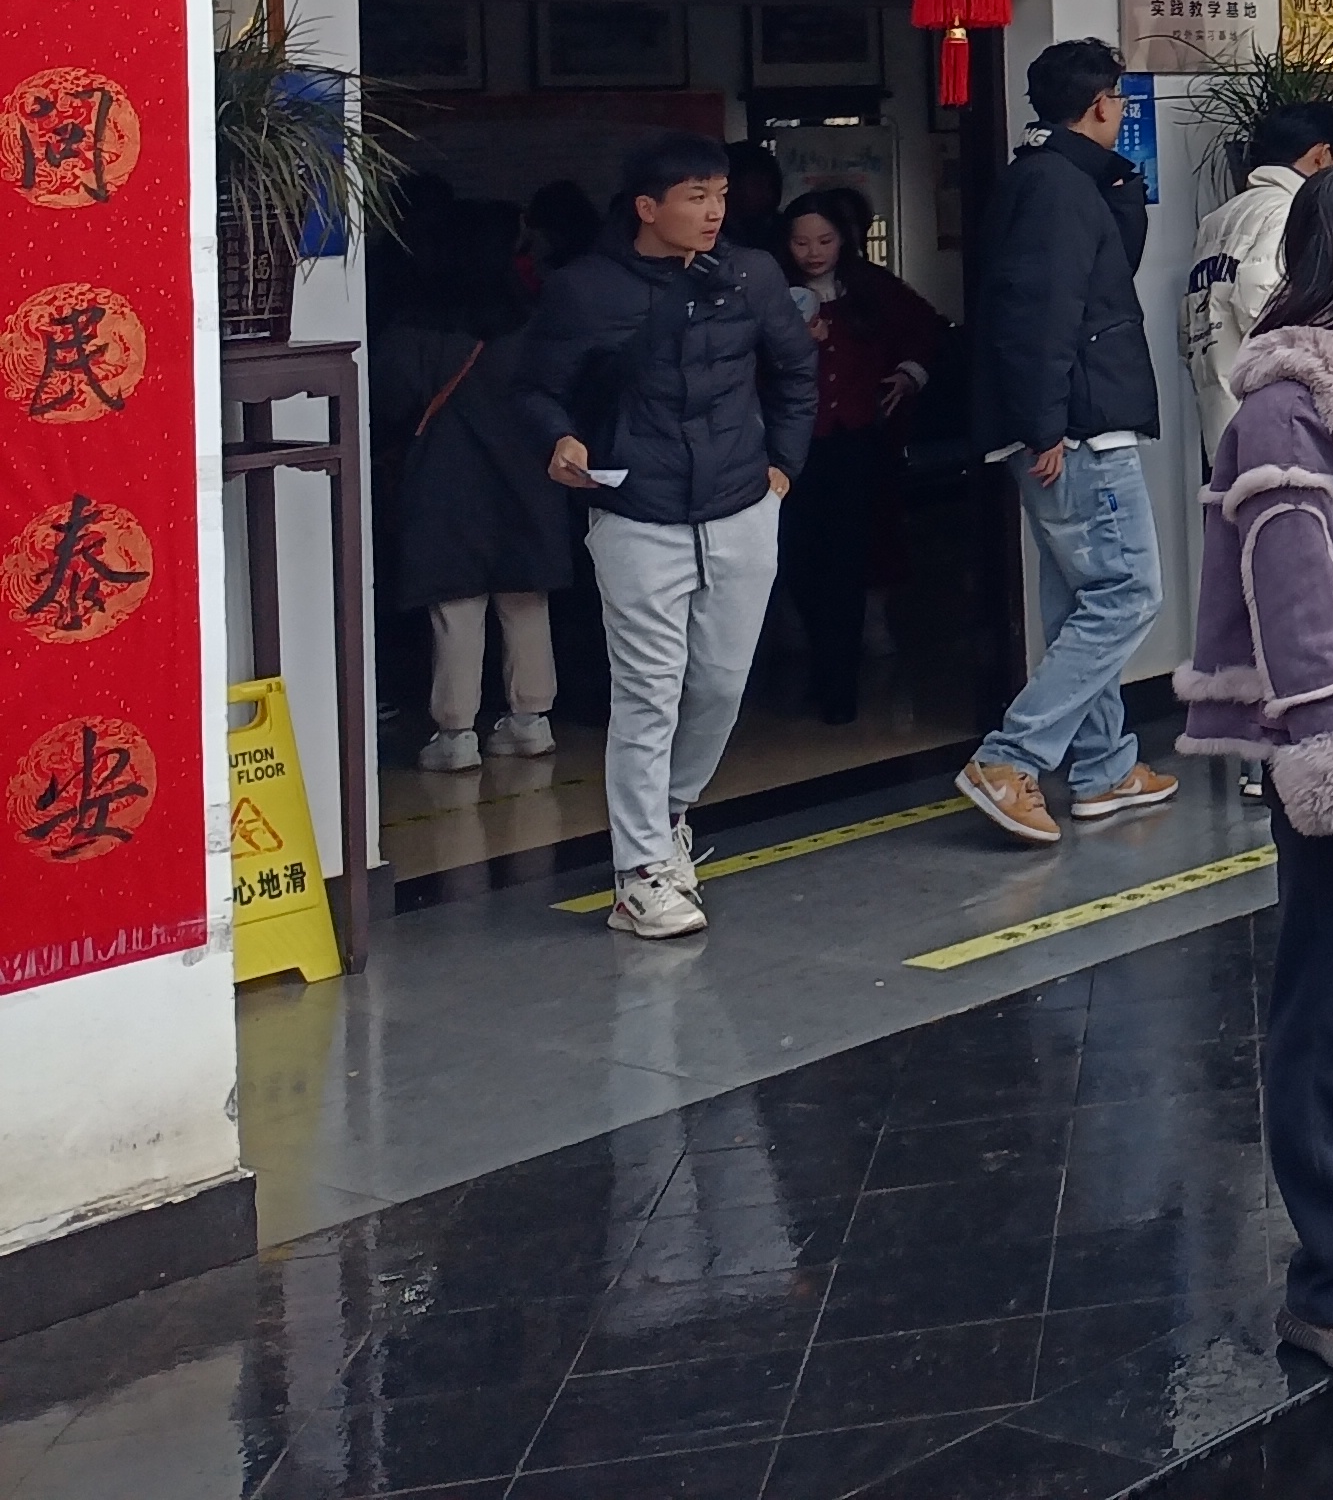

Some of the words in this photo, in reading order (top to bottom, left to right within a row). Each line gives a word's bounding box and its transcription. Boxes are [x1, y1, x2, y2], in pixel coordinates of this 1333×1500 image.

[1150, 0, 1257, 18] 实践教学基地
[237, 763, 286, 785] FLOOR
